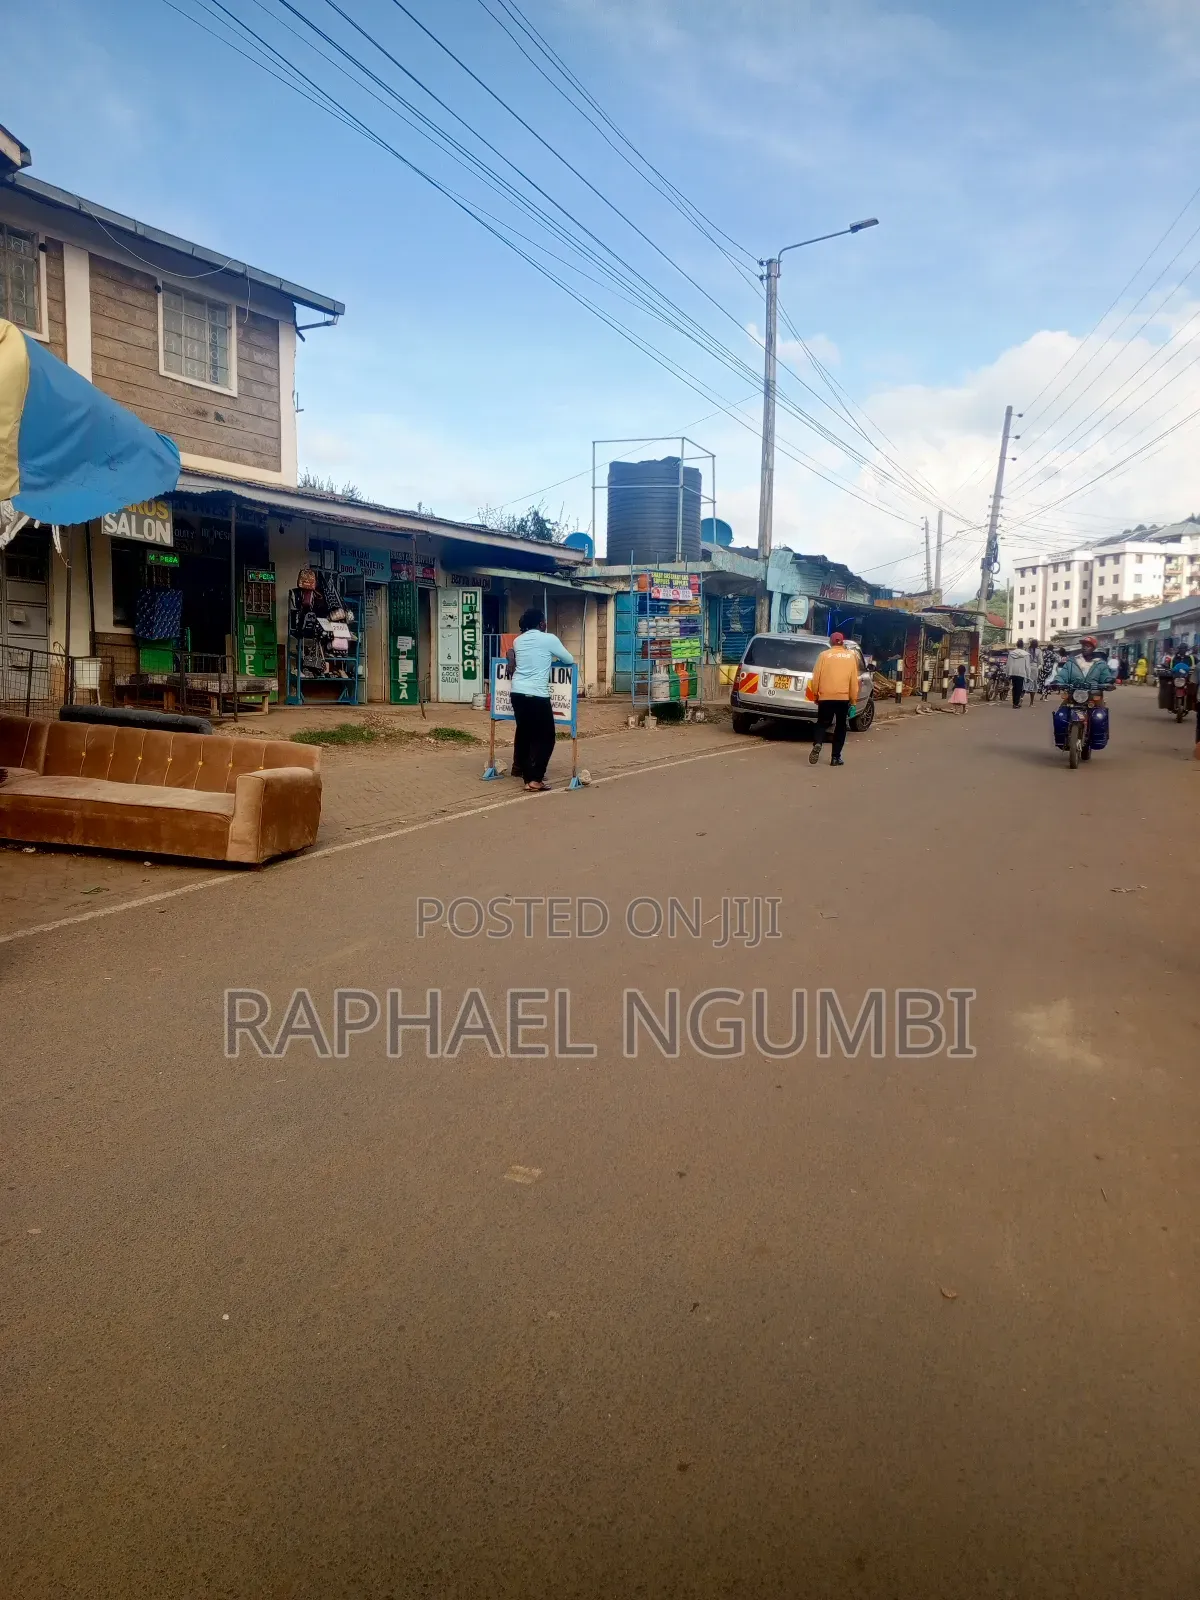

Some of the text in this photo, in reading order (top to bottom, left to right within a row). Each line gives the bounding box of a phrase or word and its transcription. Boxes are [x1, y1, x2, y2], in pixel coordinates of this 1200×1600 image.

[103, 512, 171, 545] SALON
[340, 565, 376, 577] BOOK SHOP
